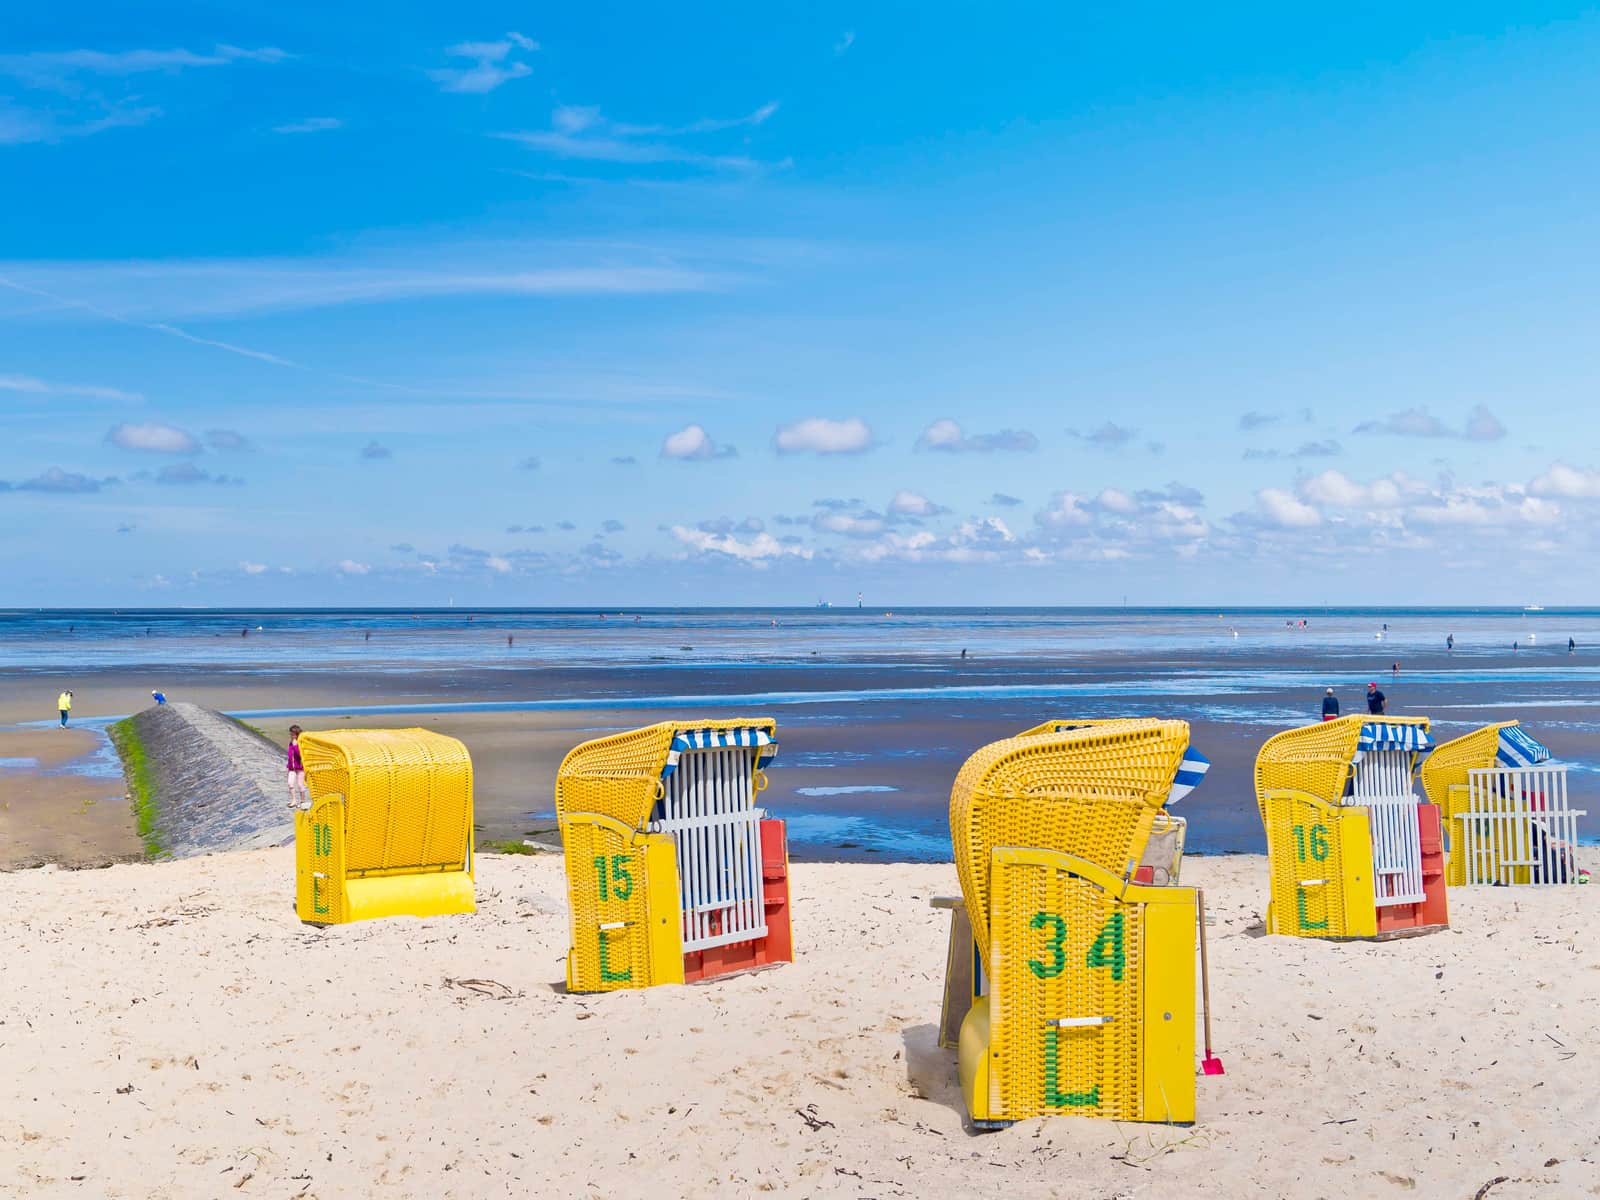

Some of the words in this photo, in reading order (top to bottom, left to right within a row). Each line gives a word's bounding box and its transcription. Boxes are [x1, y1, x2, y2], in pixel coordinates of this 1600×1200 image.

[314, 823, 331, 857] 10
[1293, 823, 1329, 862] 16
[313, 876, 329, 914] L
[593, 854, 634, 902] 15
[1296, 887, 1329, 930] L
[598, 931, 633, 982] L
[1027, 911, 1126, 983] 34
[1044, 1030, 1100, 1107] L
